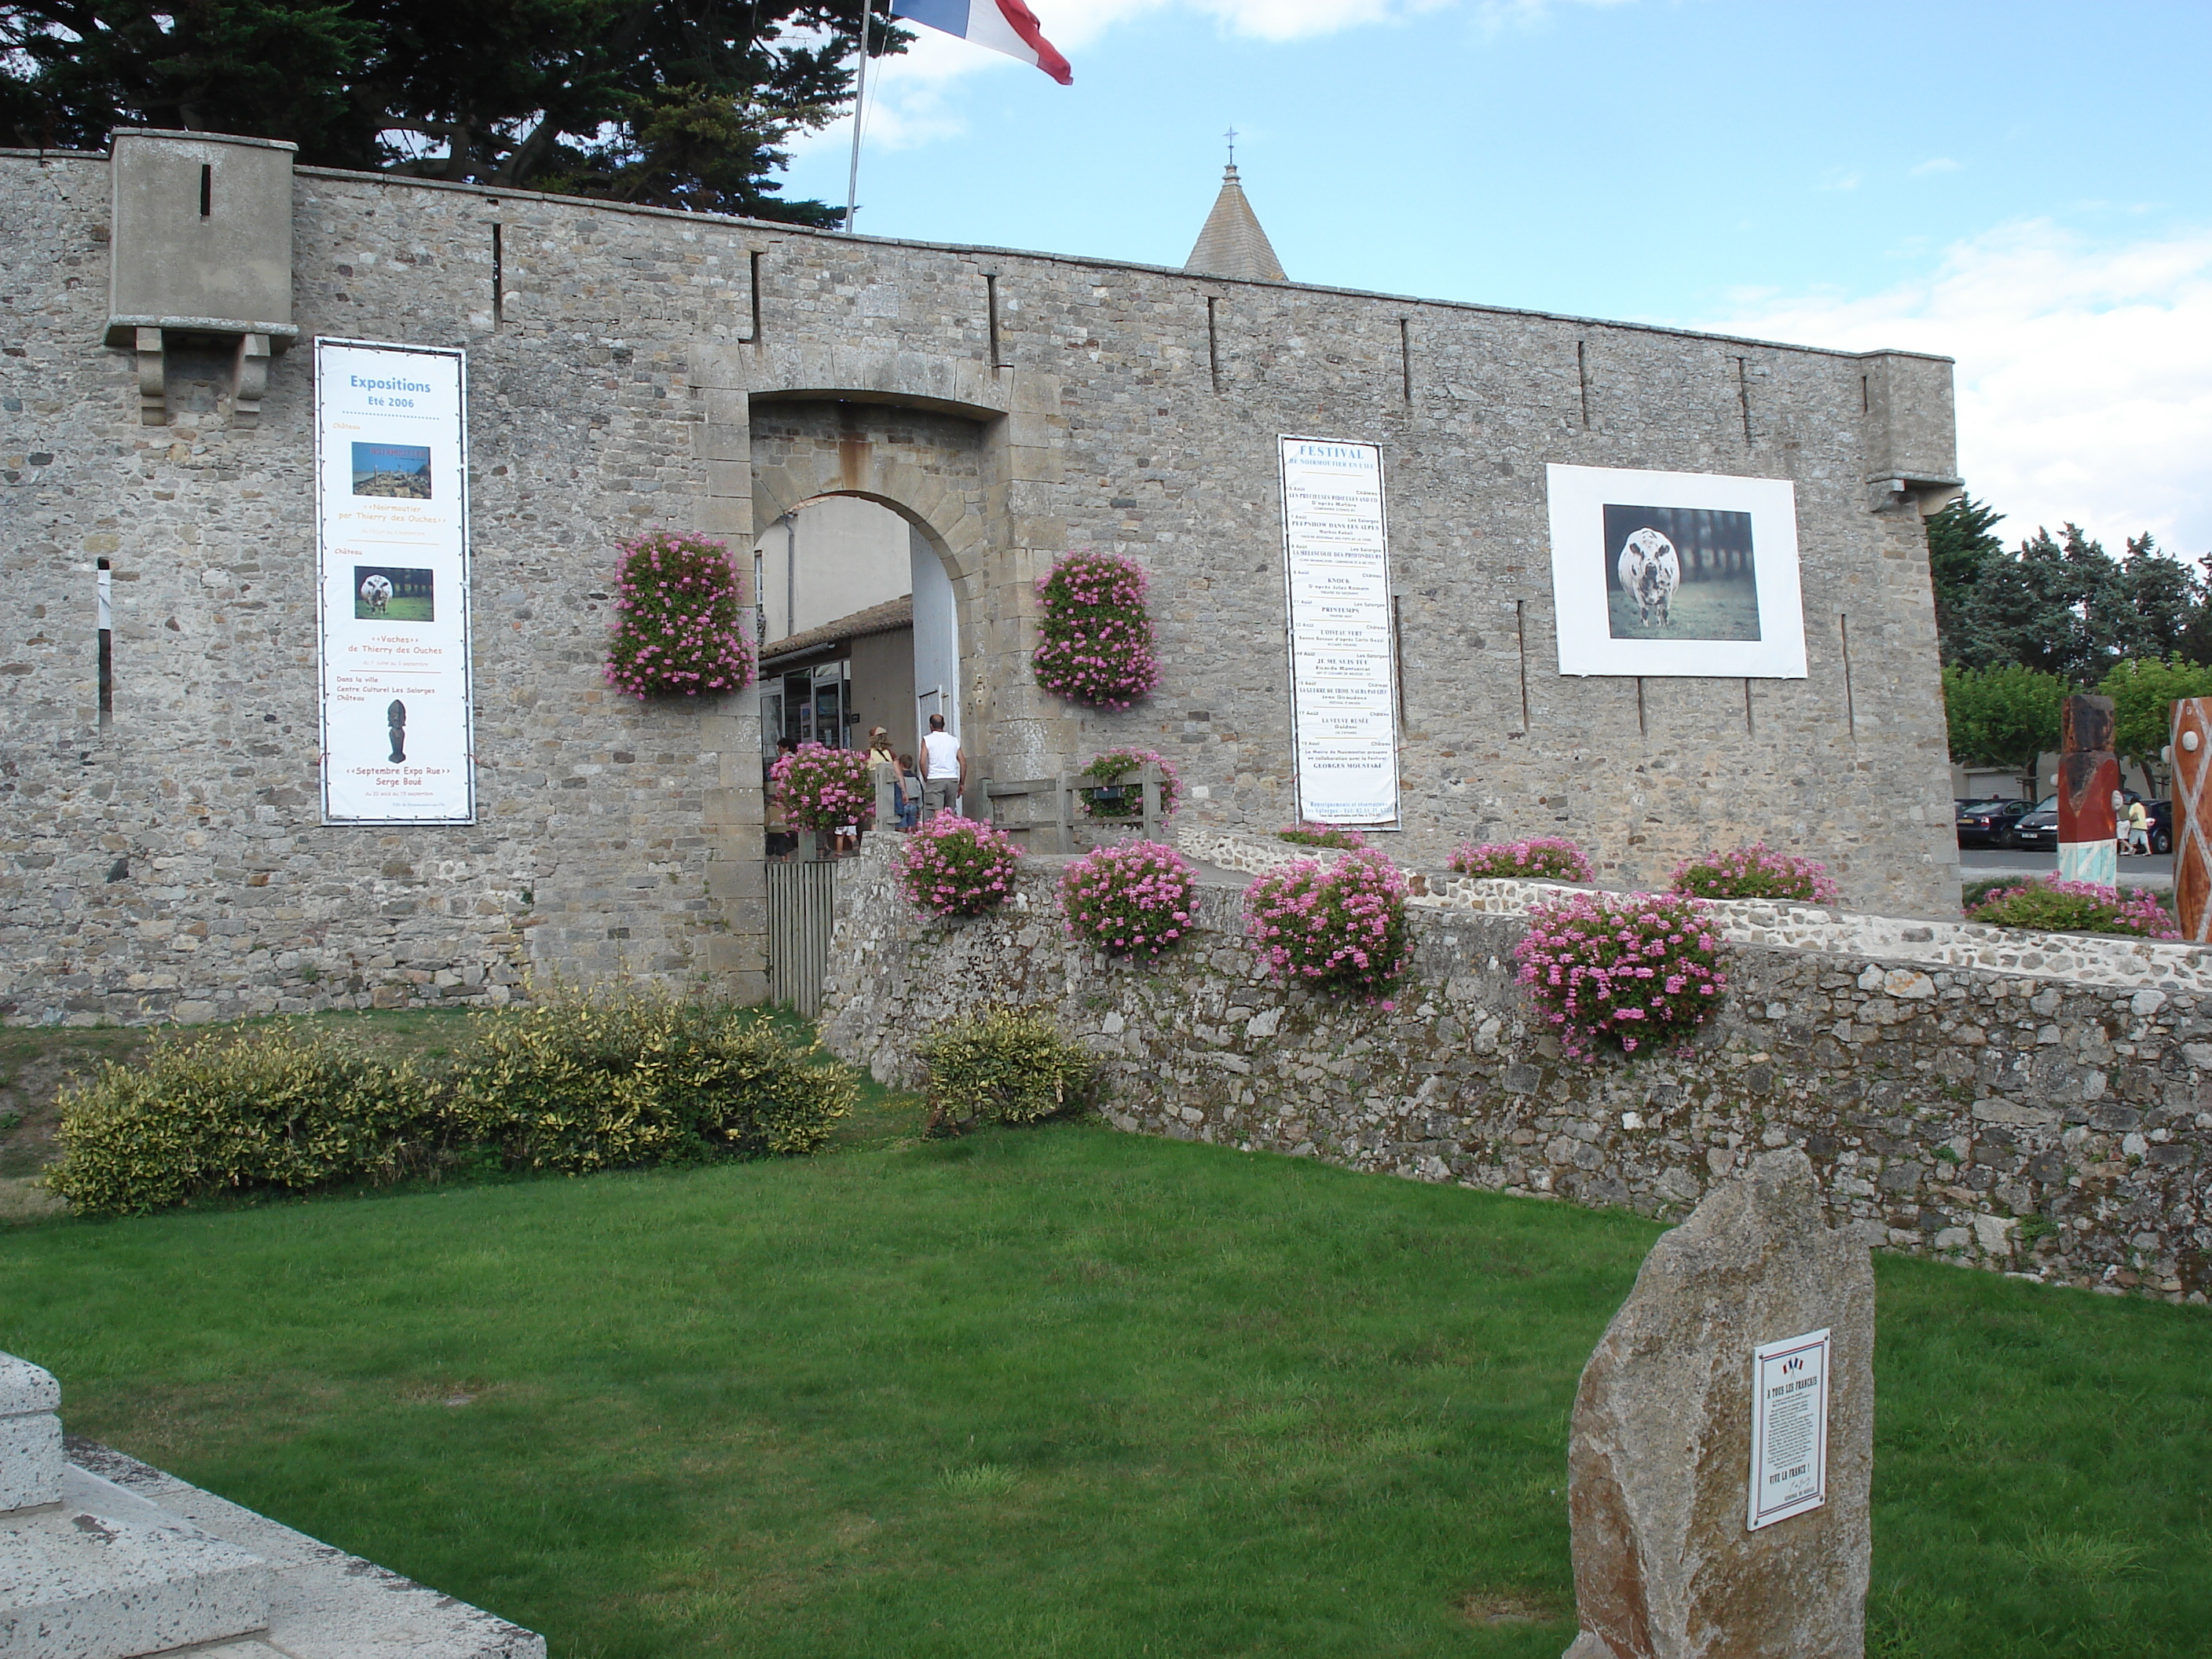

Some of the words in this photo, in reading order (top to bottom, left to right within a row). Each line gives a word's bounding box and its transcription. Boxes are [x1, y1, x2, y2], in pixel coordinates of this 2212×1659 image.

[351, 375, 431, 393] Expositions
[368, 396, 385, 407] Eté
[388, 397, 414, 408] 2006
[1300, 445, 1364, 460] FESTIVAL
[356, 512, 386, 522] Thierry
[362, 646, 393, 655] Thierry
[404, 767, 423, 777] Expo
[375, 778, 399, 787] Serge
[403, 777, 423, 786] Boué
[1767, 1389, 1771, 1399] A
[1772, 1386, 1784, 1397] TOUS
[1785, 1382, 1794, 1393] LES
[1795, 1375, 1818, 1391] FRANÇAIS
[1769, 1472, 1781, 1485] VIVE
[1782, 1470, 1787, 1481] LA
[1789, 1464, 1806, 1479] FRANCE
